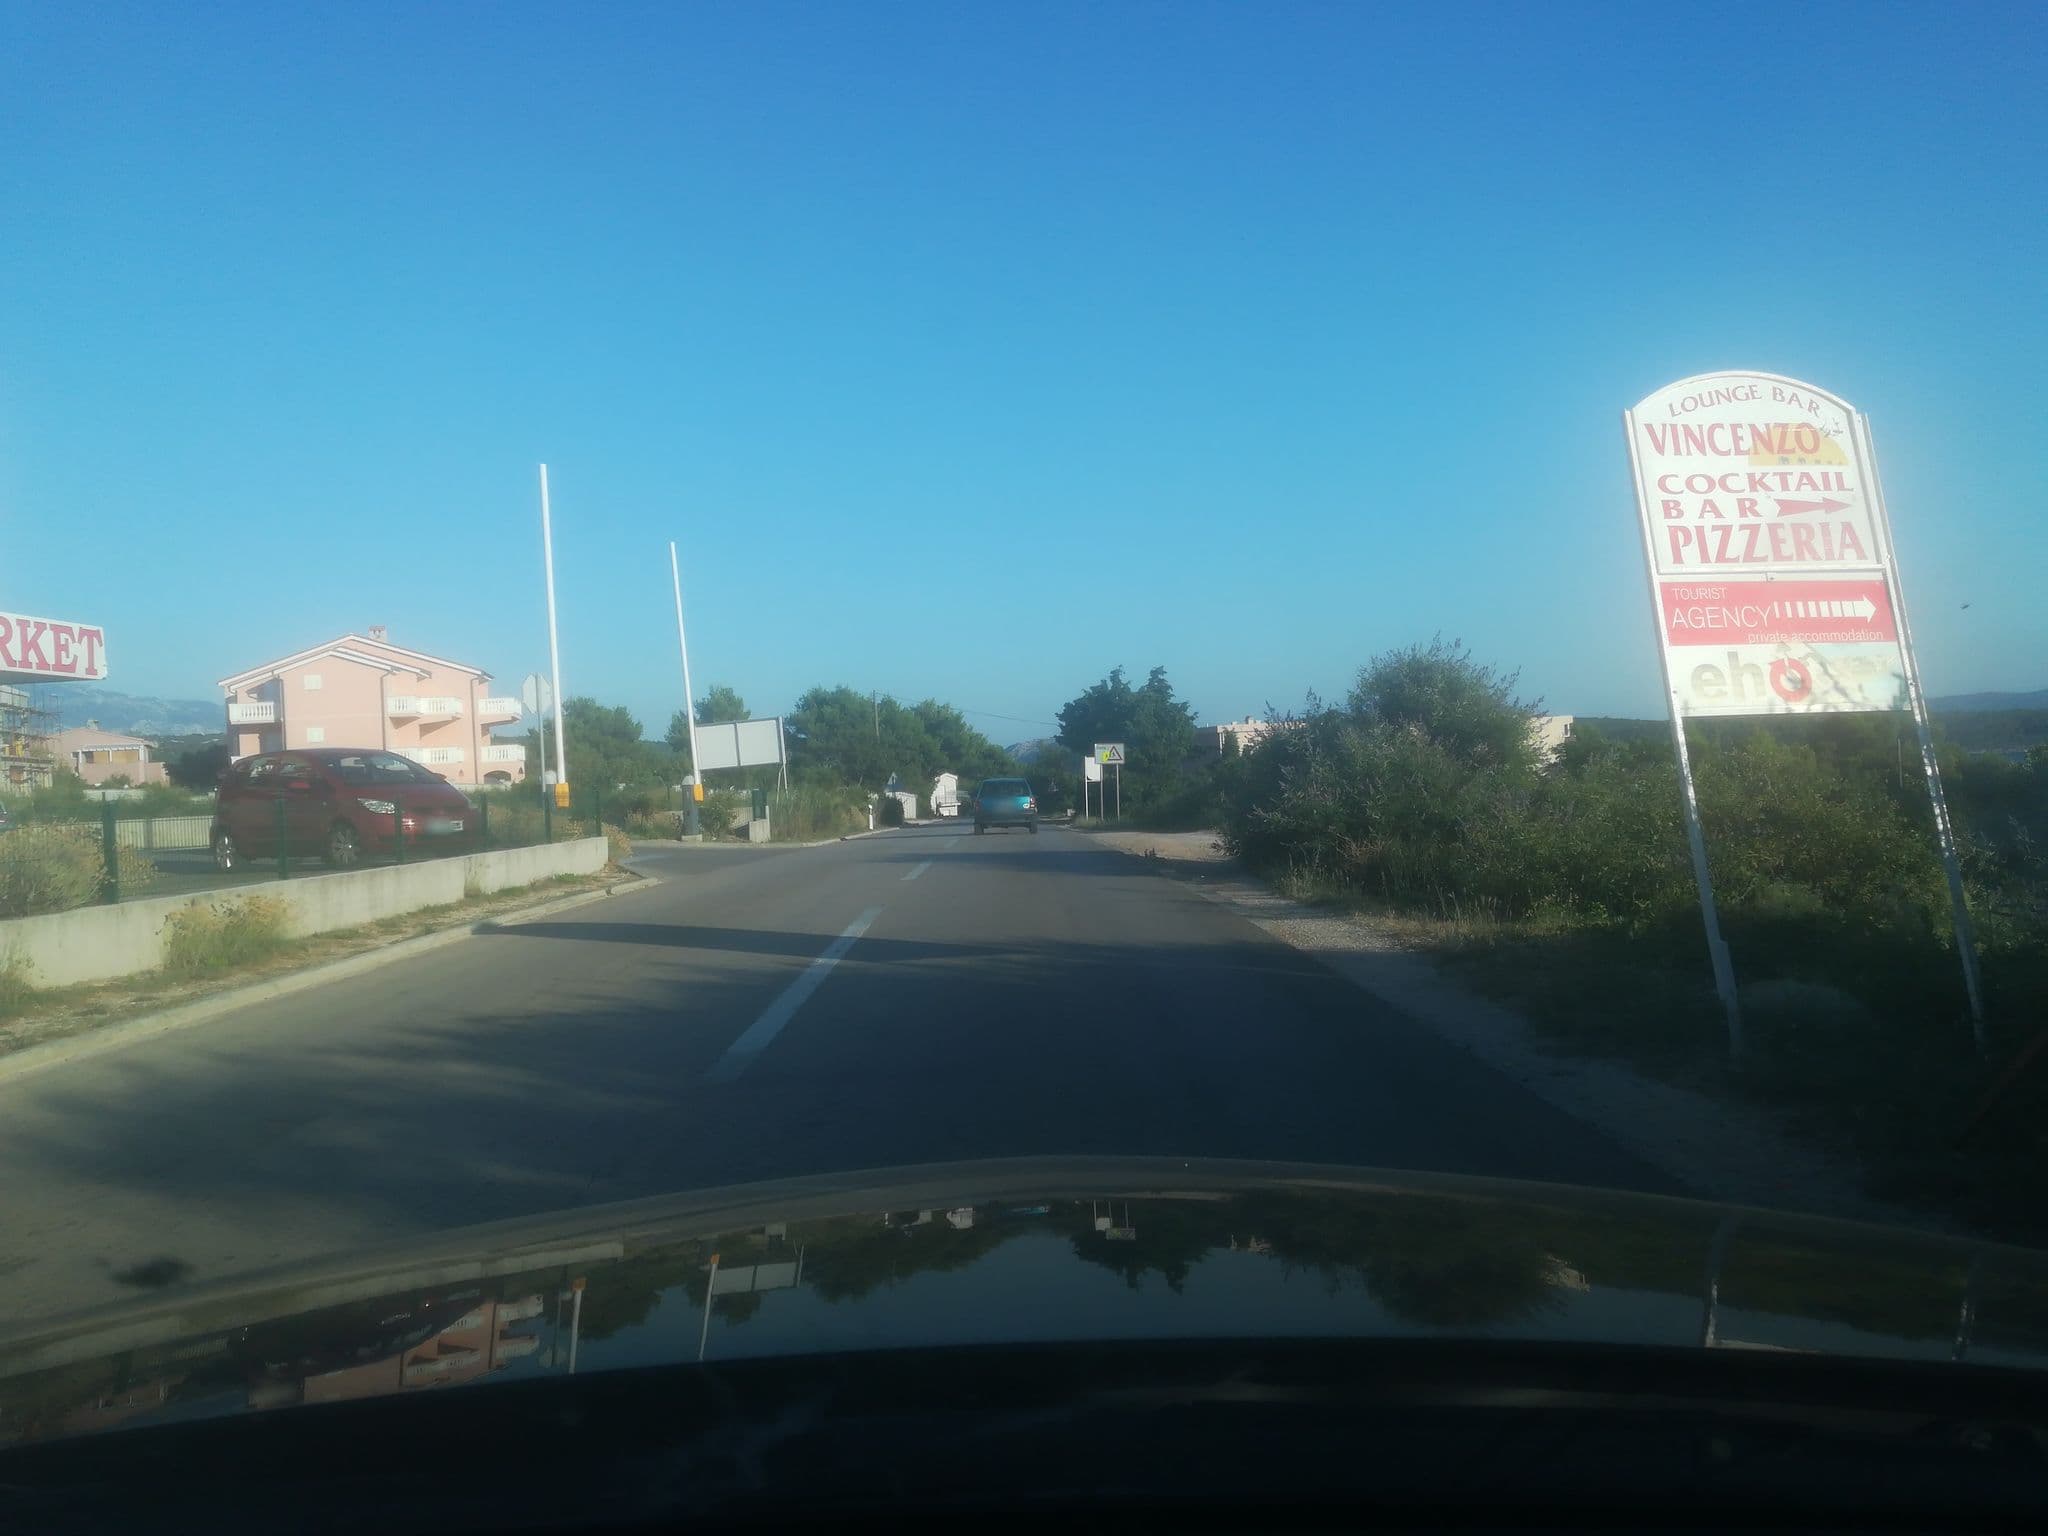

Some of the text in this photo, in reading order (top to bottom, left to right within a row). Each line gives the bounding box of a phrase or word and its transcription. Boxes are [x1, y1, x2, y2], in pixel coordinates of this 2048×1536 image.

[1668, 384, 1821, 417] LOUNGE BAR
[1644, 422, 1820, 457] VINCENZO
[1658, 471, 1854, 495] COCKTAIL
[1661, 498, 1761, 520] BAR
[1667, 521, 1868, 564] PIZZERIA
[1672, 587, 1727, 600] TOURIST
[1672, 606, 1771, 629] AGENCY
[1747, 629, 1883, 644] private accommodation
